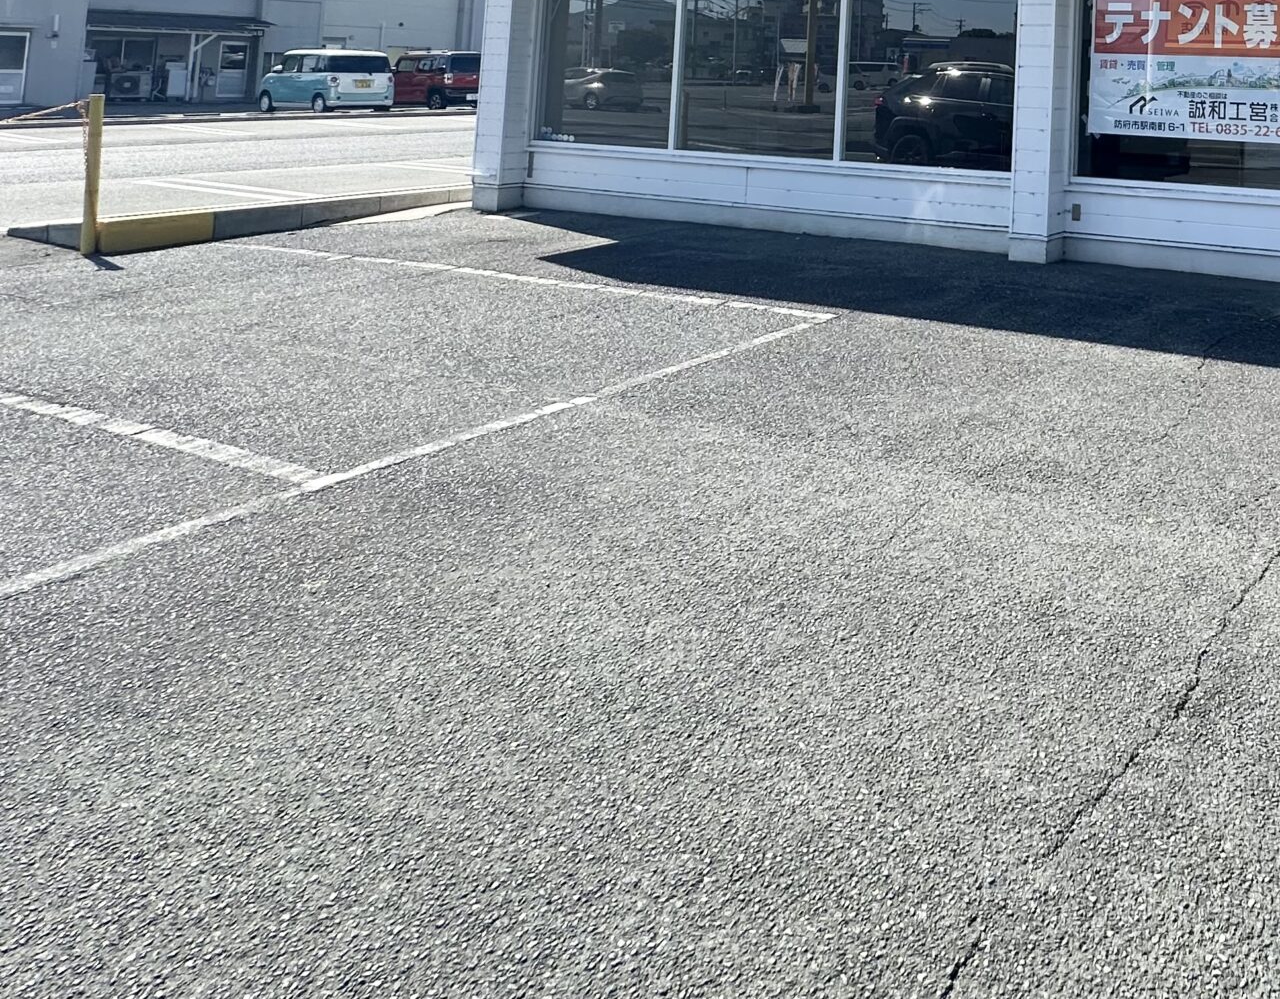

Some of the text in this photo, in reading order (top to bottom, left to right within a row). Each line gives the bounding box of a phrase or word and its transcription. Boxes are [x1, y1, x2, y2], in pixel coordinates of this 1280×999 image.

[1176, 90, 1228, 100] 不動産のご相談は
[1147, 108, 1180, 117] SEIWA
[1190, 121, 1213, 134] TEL
